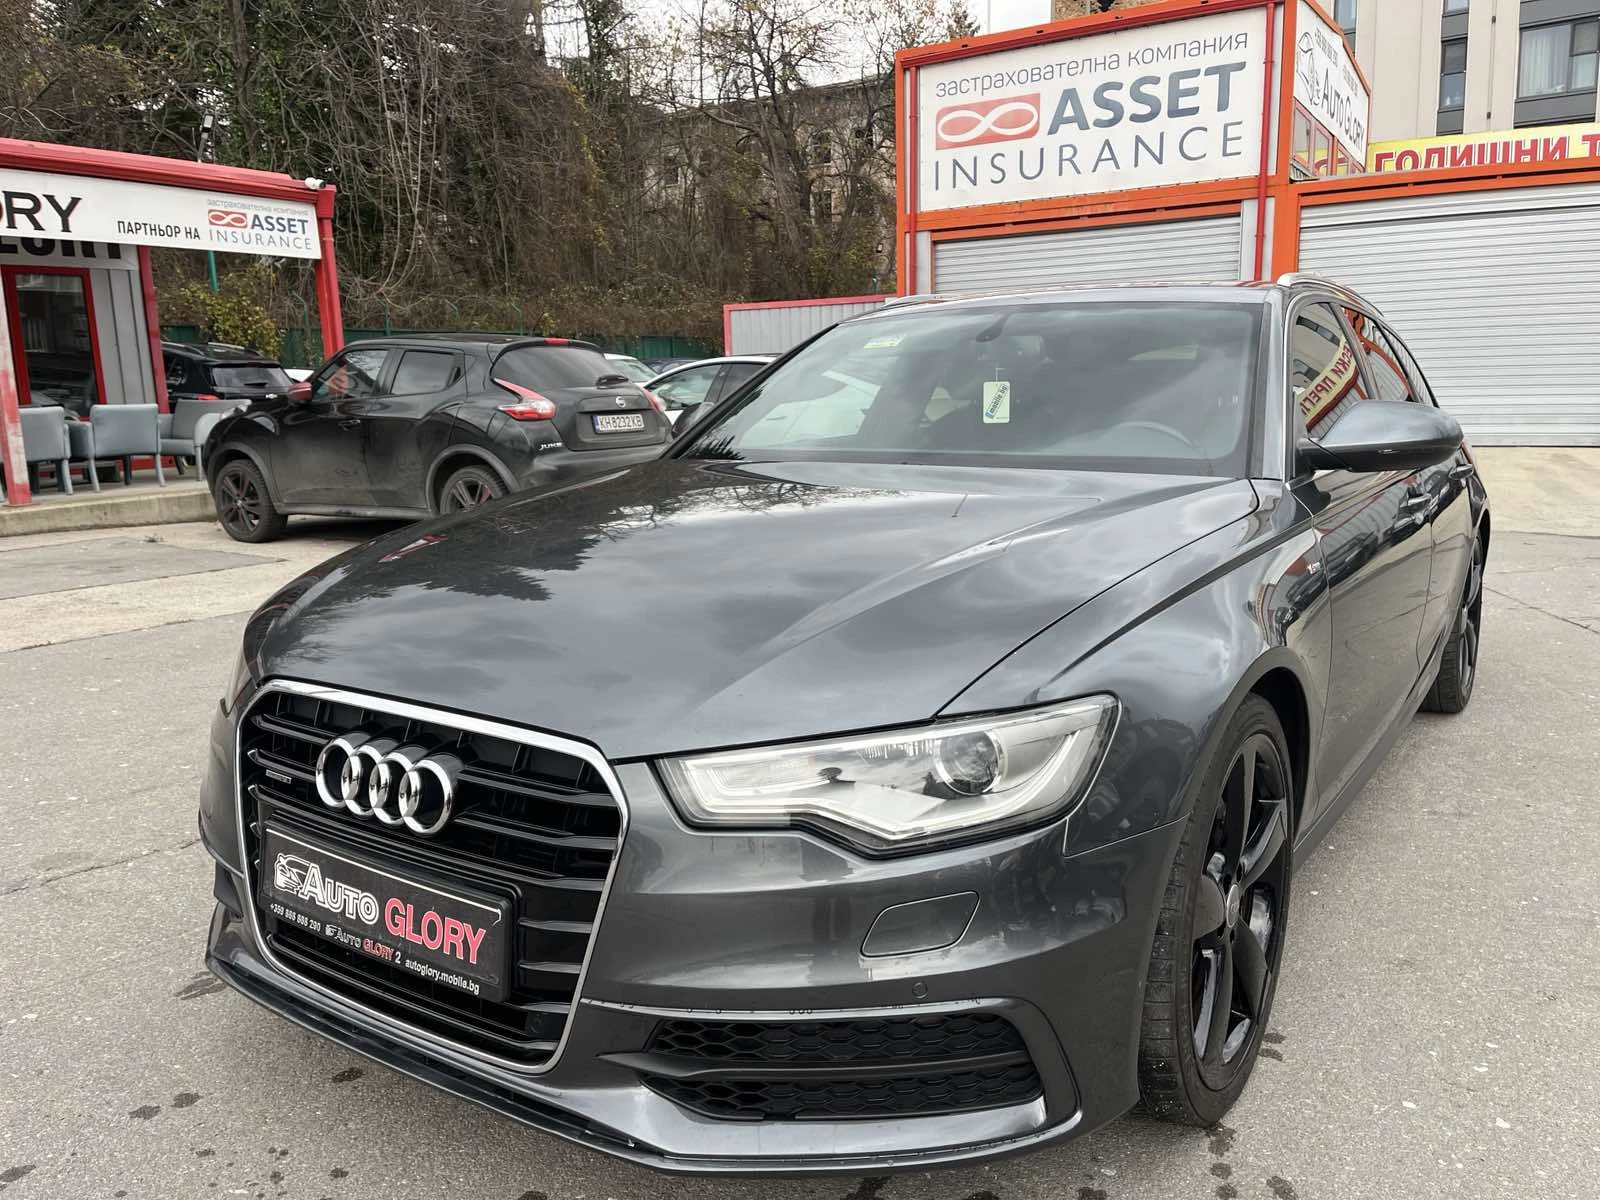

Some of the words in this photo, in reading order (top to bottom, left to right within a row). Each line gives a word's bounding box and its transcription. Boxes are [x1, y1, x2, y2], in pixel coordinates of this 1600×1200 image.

[935, 52, 1120, 97] застрахователна
[1127, 32, 1248, 67] компания
[1048, 61, 1247, 136] ASSET
[934, 121, 1244, 191] INSURANCE
[0, 190, 82, 233] RY
[117, 220, 181, 239] ПАРТНЬОР
[185, 226, 201, 241] НА
[251, 214, 309, 235] ASSET
[208, 229, 312, 250] INSURANCE
[298, 862, 380, 925] AUTO
[385, 897, 486, 964] GLORY
[335, 926, 362, 949] AUTO
[362, 938, 395, 961] GLORY
[395, 951, 402, 964] 2
[404, 958, 481, 996] autoglory.mobile.bg
